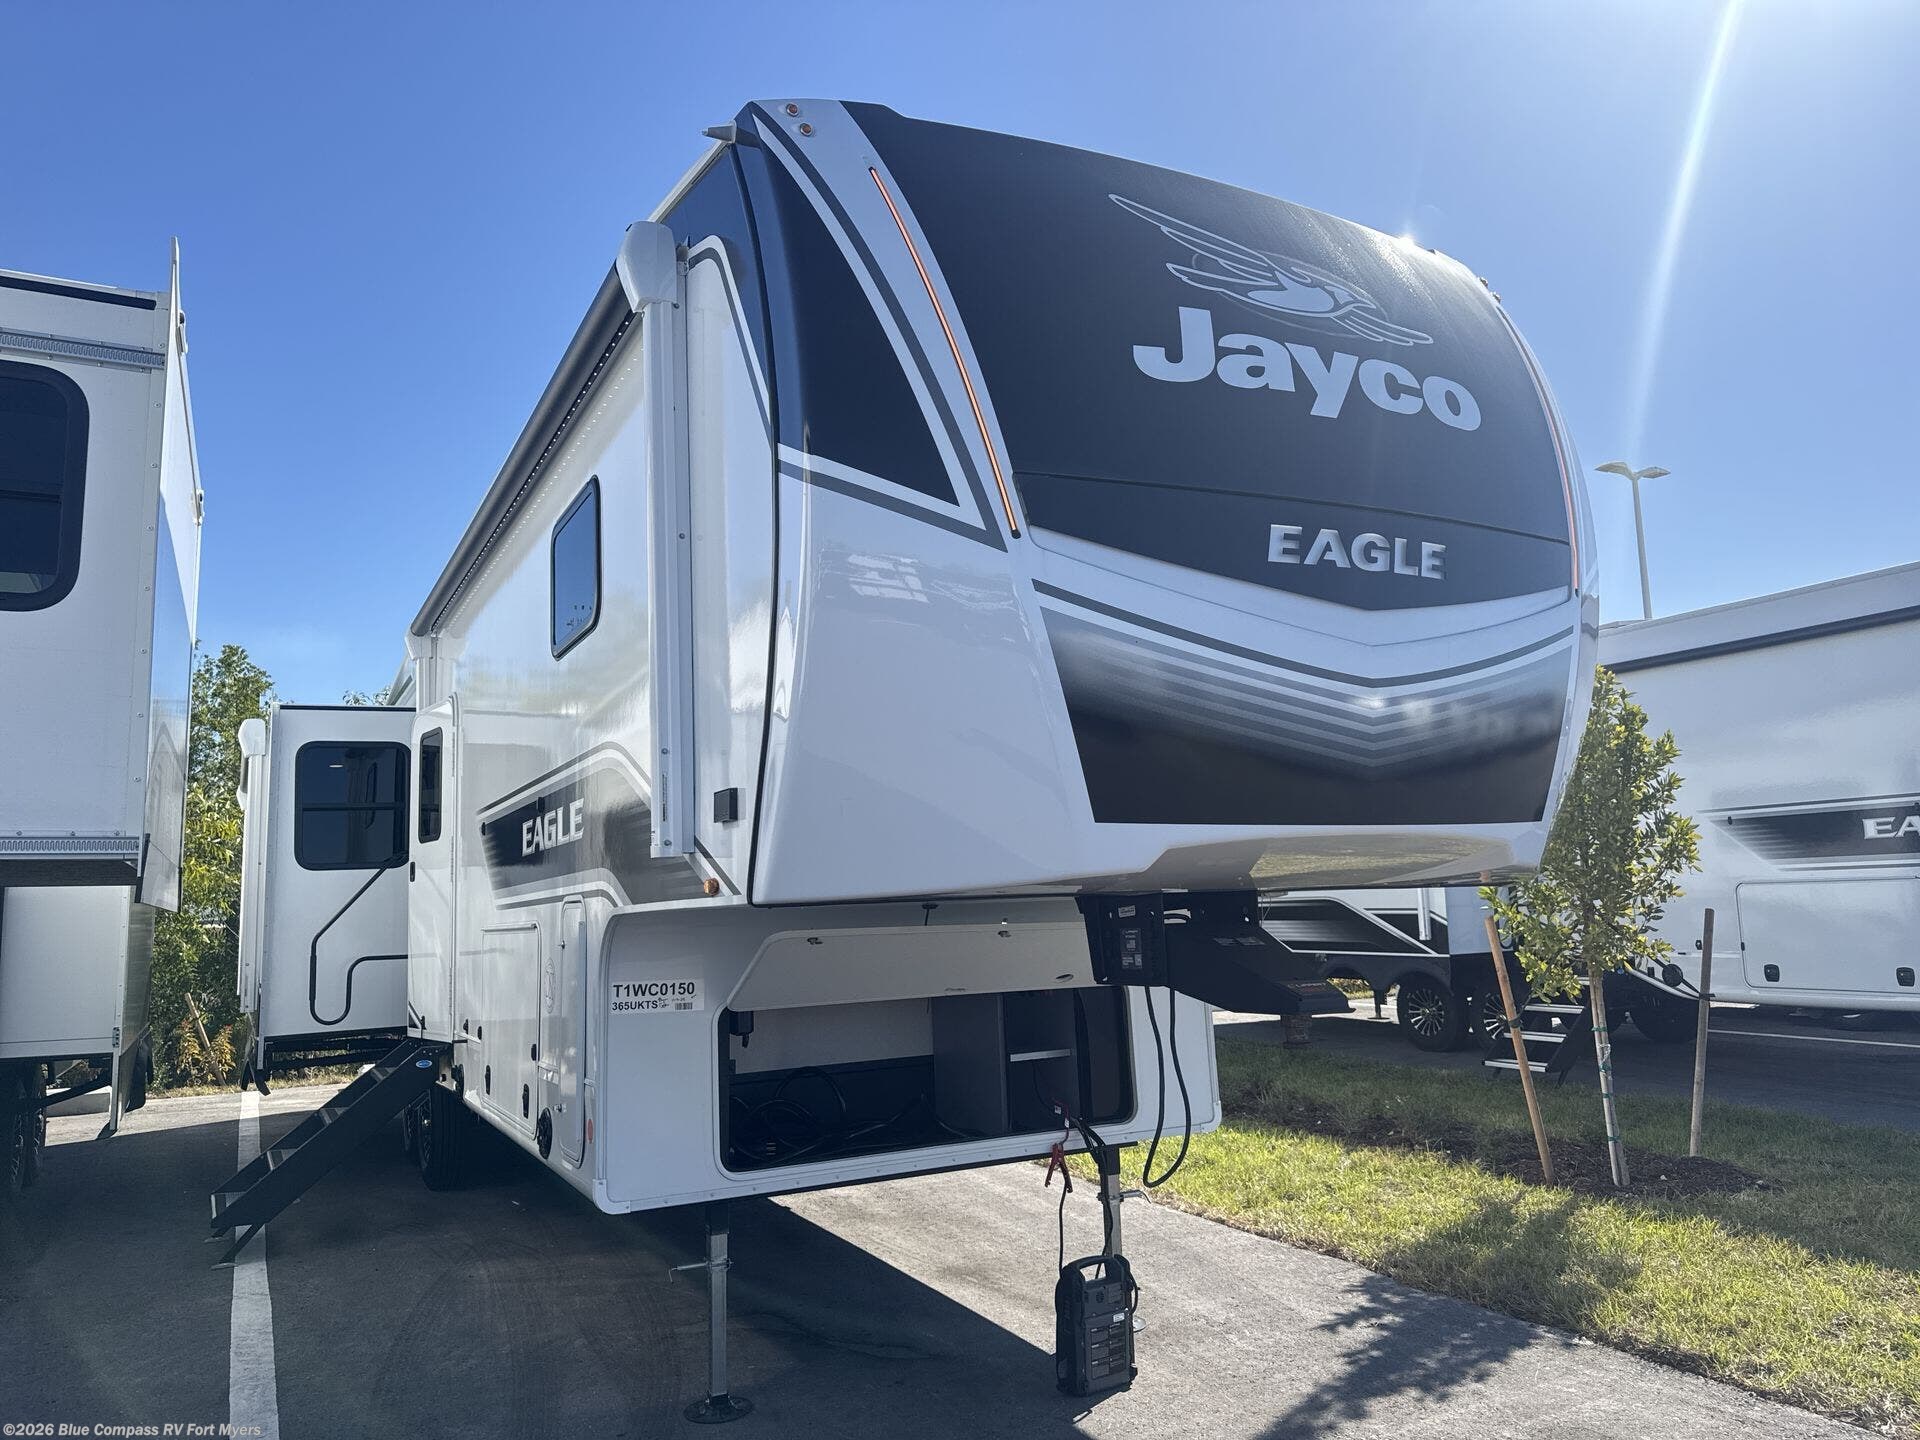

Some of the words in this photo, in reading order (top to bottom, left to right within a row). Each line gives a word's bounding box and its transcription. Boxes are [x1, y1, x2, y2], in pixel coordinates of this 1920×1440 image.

[1133, 306, 1482, 431] Jayco
[1267, 524, 1447, 580] EAGLE
[522, 798, 585, 857] EAGLE
[612, 1000, 658, 1011] 365UKTS
[613, 982, 695, 998] T1WC0150
